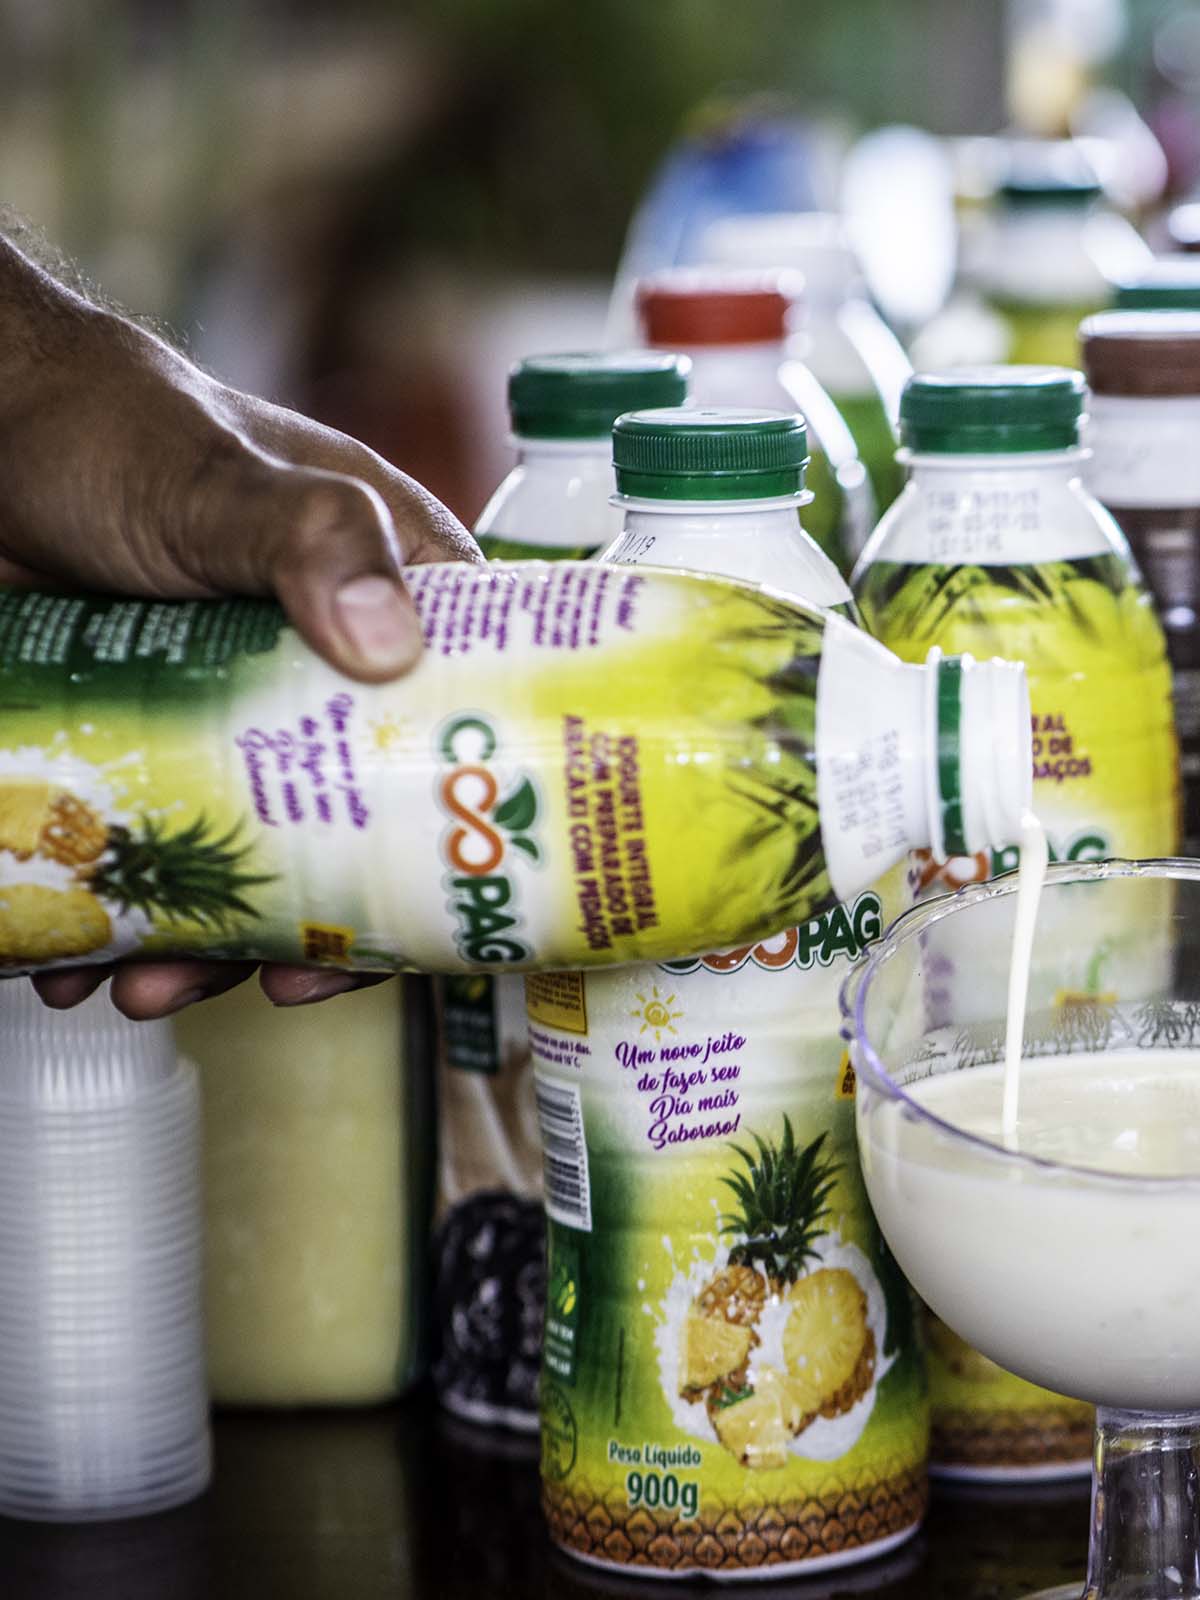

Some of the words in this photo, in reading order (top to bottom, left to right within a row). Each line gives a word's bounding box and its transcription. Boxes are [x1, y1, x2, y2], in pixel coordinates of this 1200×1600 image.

[615, 1041, 655, 1070] Um
[660, 1044, 703, 1062] novo
[701, 1032, 746, 1064] jeito
[637, 1073, 660, 1092] de
[660, 1067, 707, 1095] fazer
[711, 1065, 741, 1082] seu
[649, 1094, 693, 1121] Dia
[698, 1089, 739, 1112] mais
[648, 1114, 741, 1150] Saboroso!
[609, 1441, 641, 1462] Peso
[627, 1471, 698, 1518] 900g
